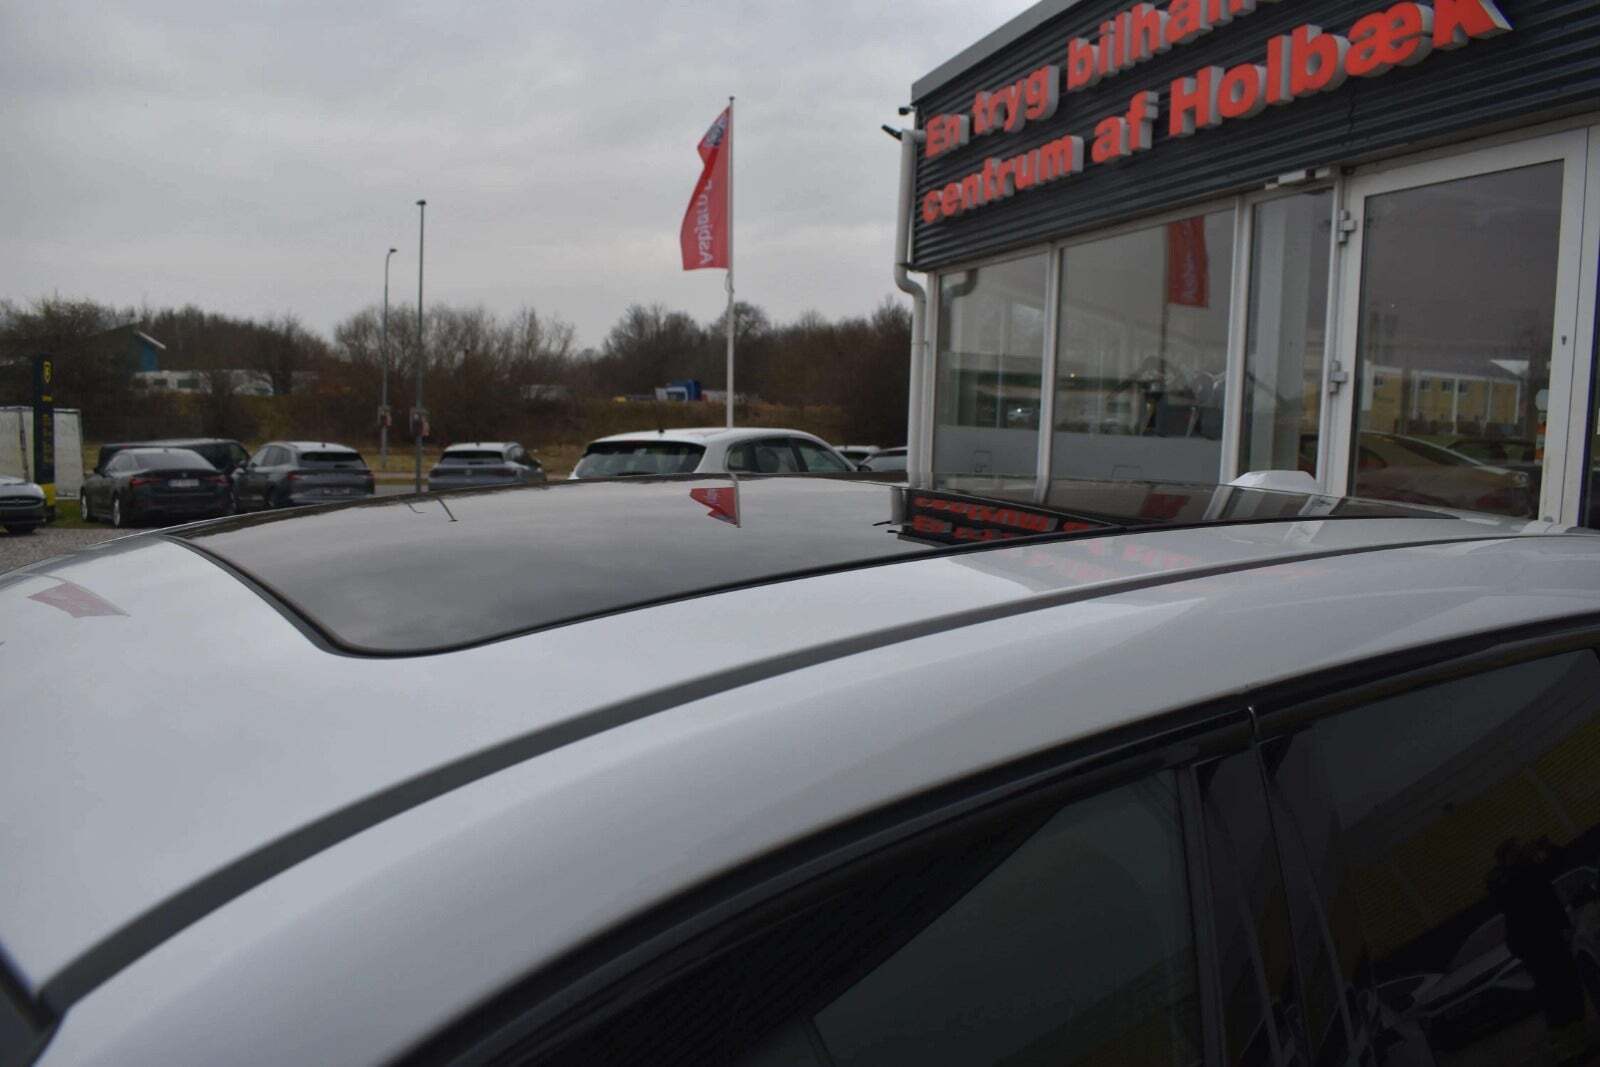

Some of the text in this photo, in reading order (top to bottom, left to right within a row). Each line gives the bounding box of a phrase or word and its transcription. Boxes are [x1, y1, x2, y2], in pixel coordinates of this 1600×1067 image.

[921, 135, 1084, 224] centrum
[1091, 90, 1158, 163] af
[925, 113, 968, 158] En
[972, 64, 1059, 134] tryg
